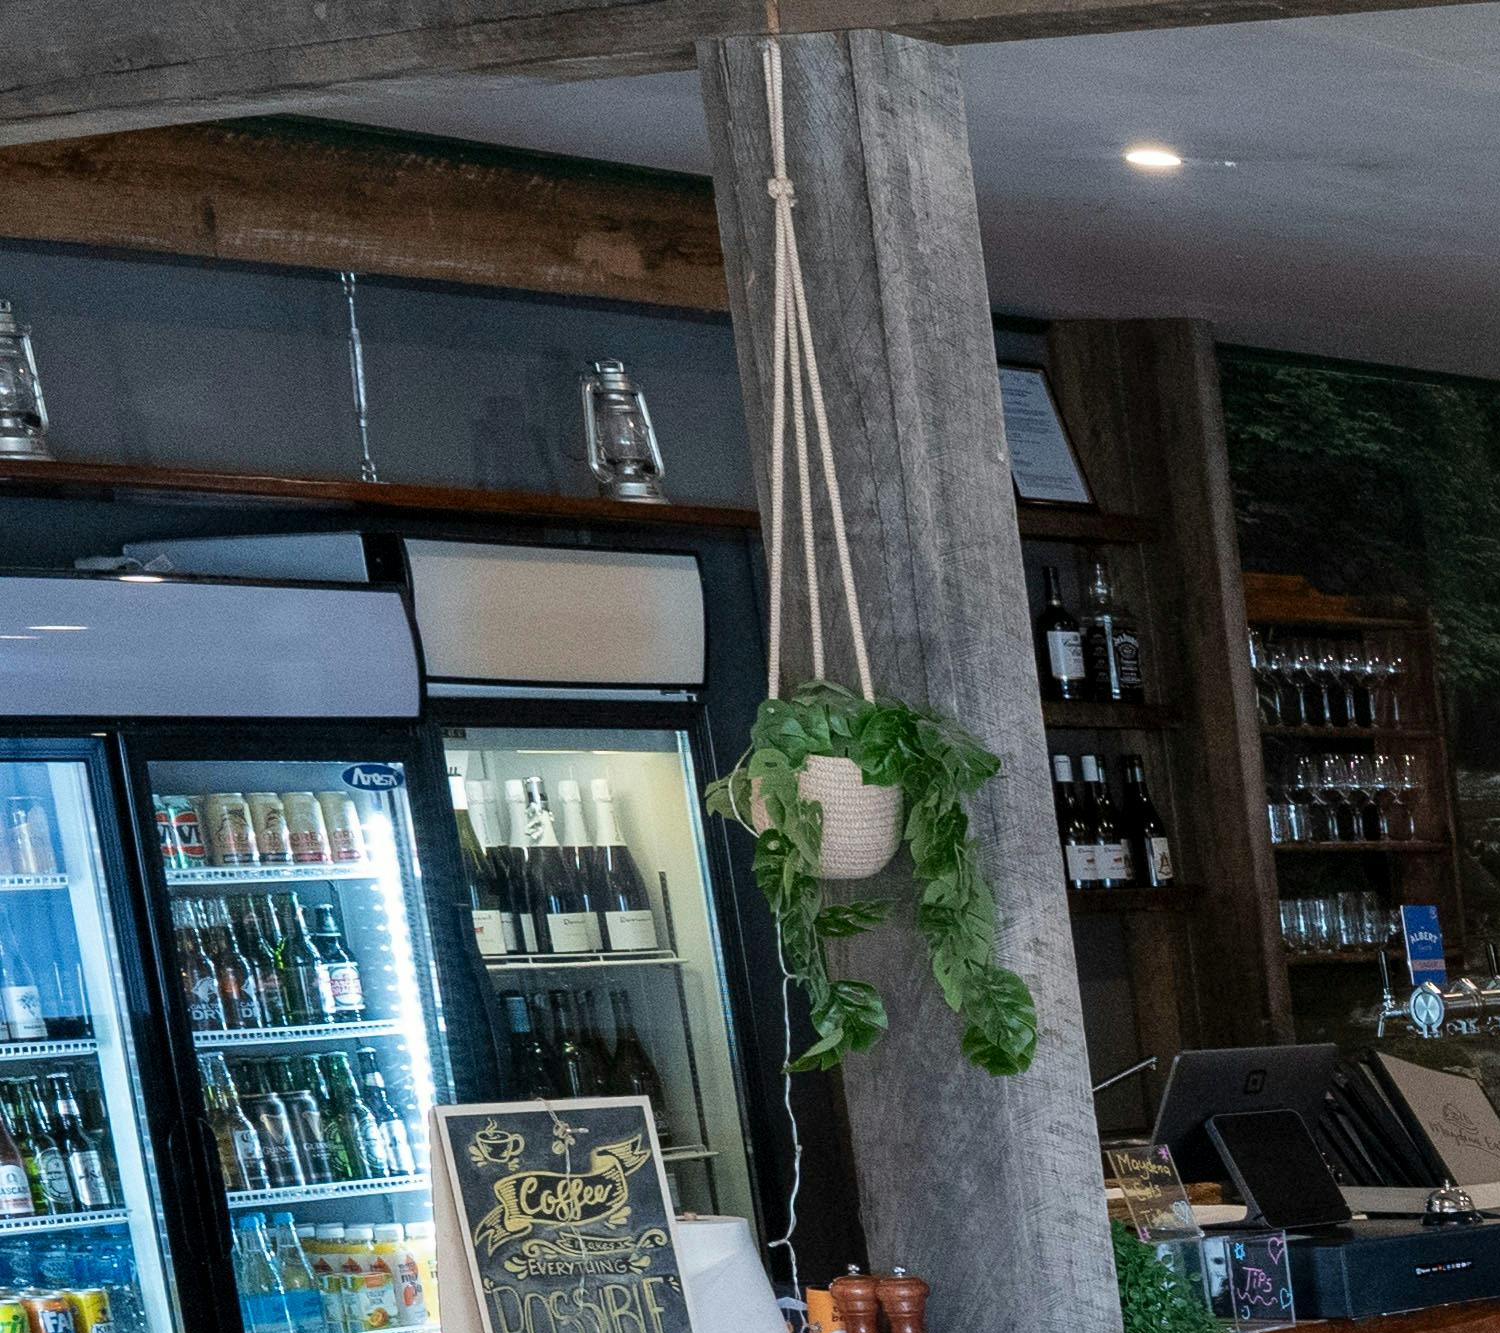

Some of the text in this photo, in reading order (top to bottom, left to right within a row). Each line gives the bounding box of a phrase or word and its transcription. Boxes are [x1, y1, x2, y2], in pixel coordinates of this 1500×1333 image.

[1410, 931, 1438, 945] ALBERT
[520, 1177, 611, 1222] Coffee
[528, 1258, 628, 1276] EVERYTHING
